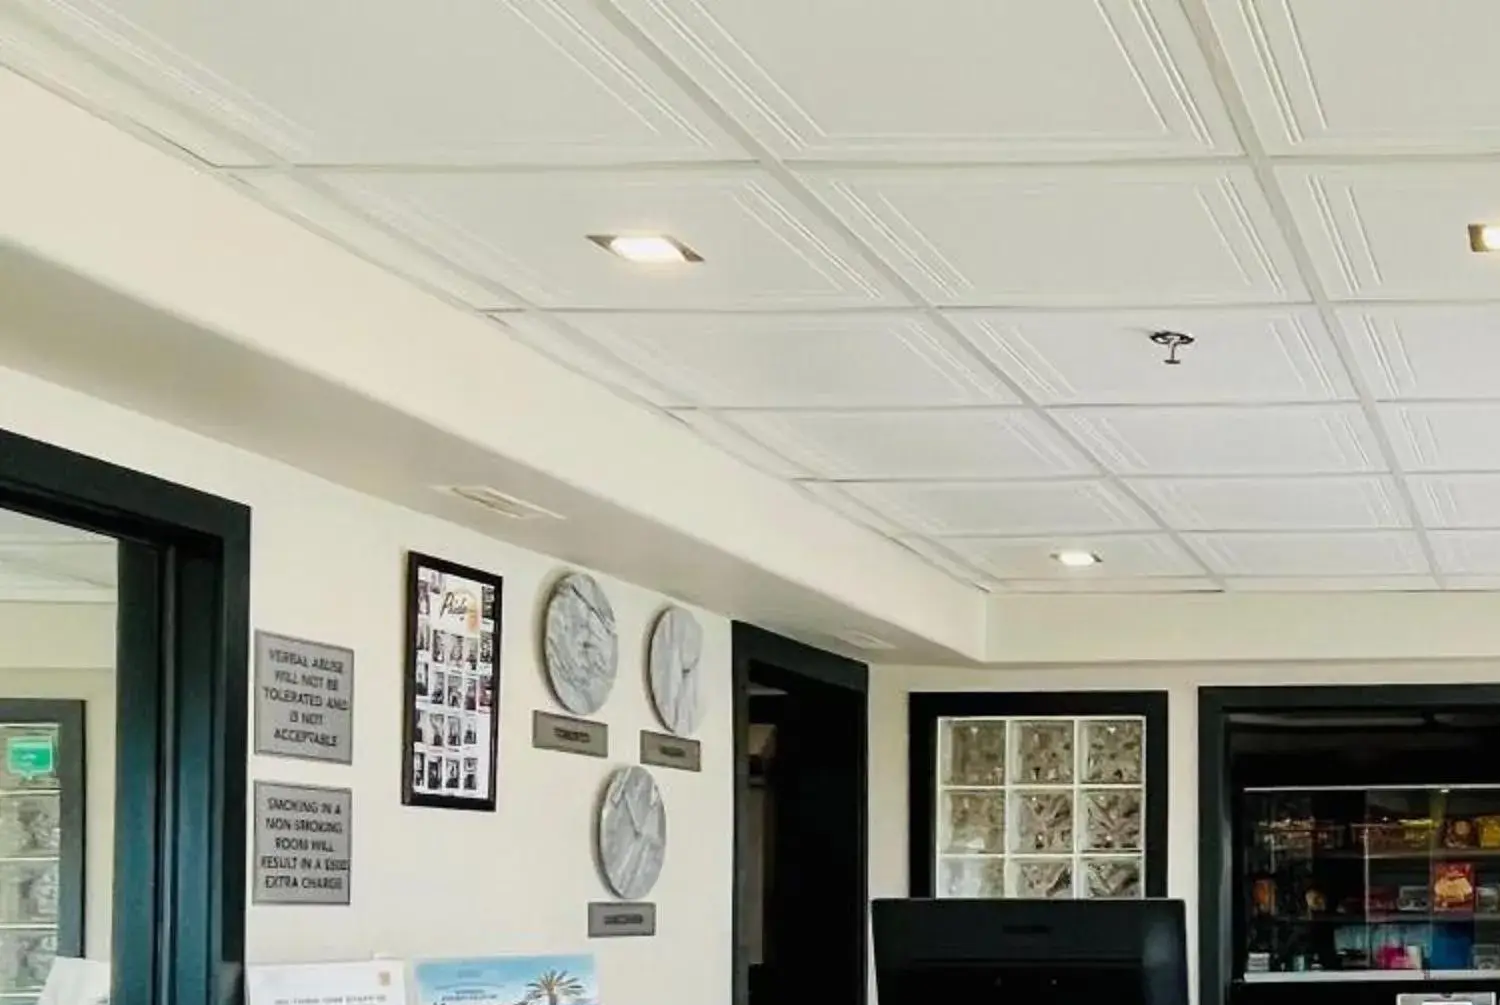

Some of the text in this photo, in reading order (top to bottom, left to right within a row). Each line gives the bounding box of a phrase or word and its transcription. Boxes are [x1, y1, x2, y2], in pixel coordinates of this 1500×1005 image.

[268, 648, 308, 668] VERBAL
[275, 669, 338, 691] WILL NOT BE
[262, 685, 322, 707] TOLERATED
[301, 712, 323, 725] NOT
[273, 728, 337, 747] ACCEPTABLE
[266, 797, 319, 814] SMOKING
[265, 817, 342, 834] NON SMOKING
[275, 837, 309, 851] ROOM
[261, 855, 297, 869] RESULT
[300, 857, 312, 870] IN
[265, 875, 342, 890] EXTRA CHARGE
